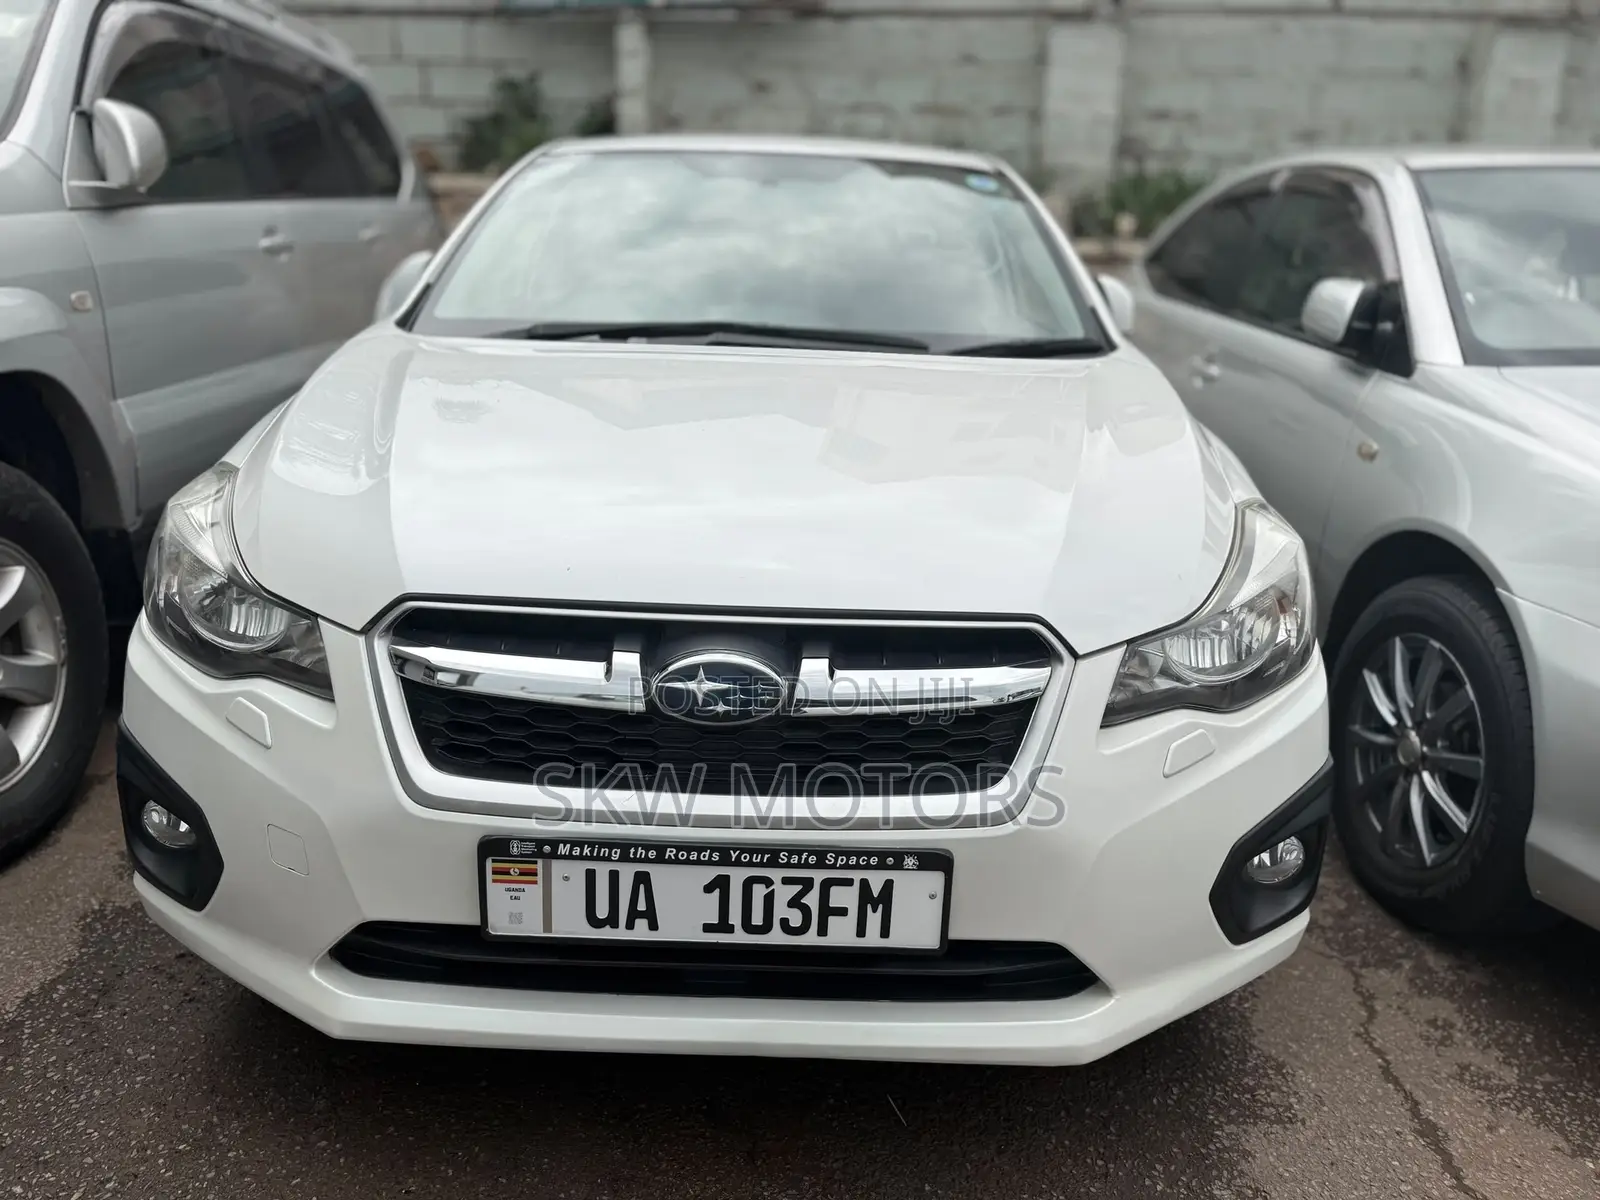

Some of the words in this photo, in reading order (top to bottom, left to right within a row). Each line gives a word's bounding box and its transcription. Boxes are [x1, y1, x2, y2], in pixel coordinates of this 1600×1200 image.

[557, 843, 621, 860] Making
[629, 847, 657, 859] the
[665, 848, 720, 861] Roads
[729, 850, 770, 863] Your
[778, 852, 817, 864] Safe
[825, 853, 879, 867] Space
[585, 868, 659, 932] UA
[702, 874, 895, 939] 103FM
